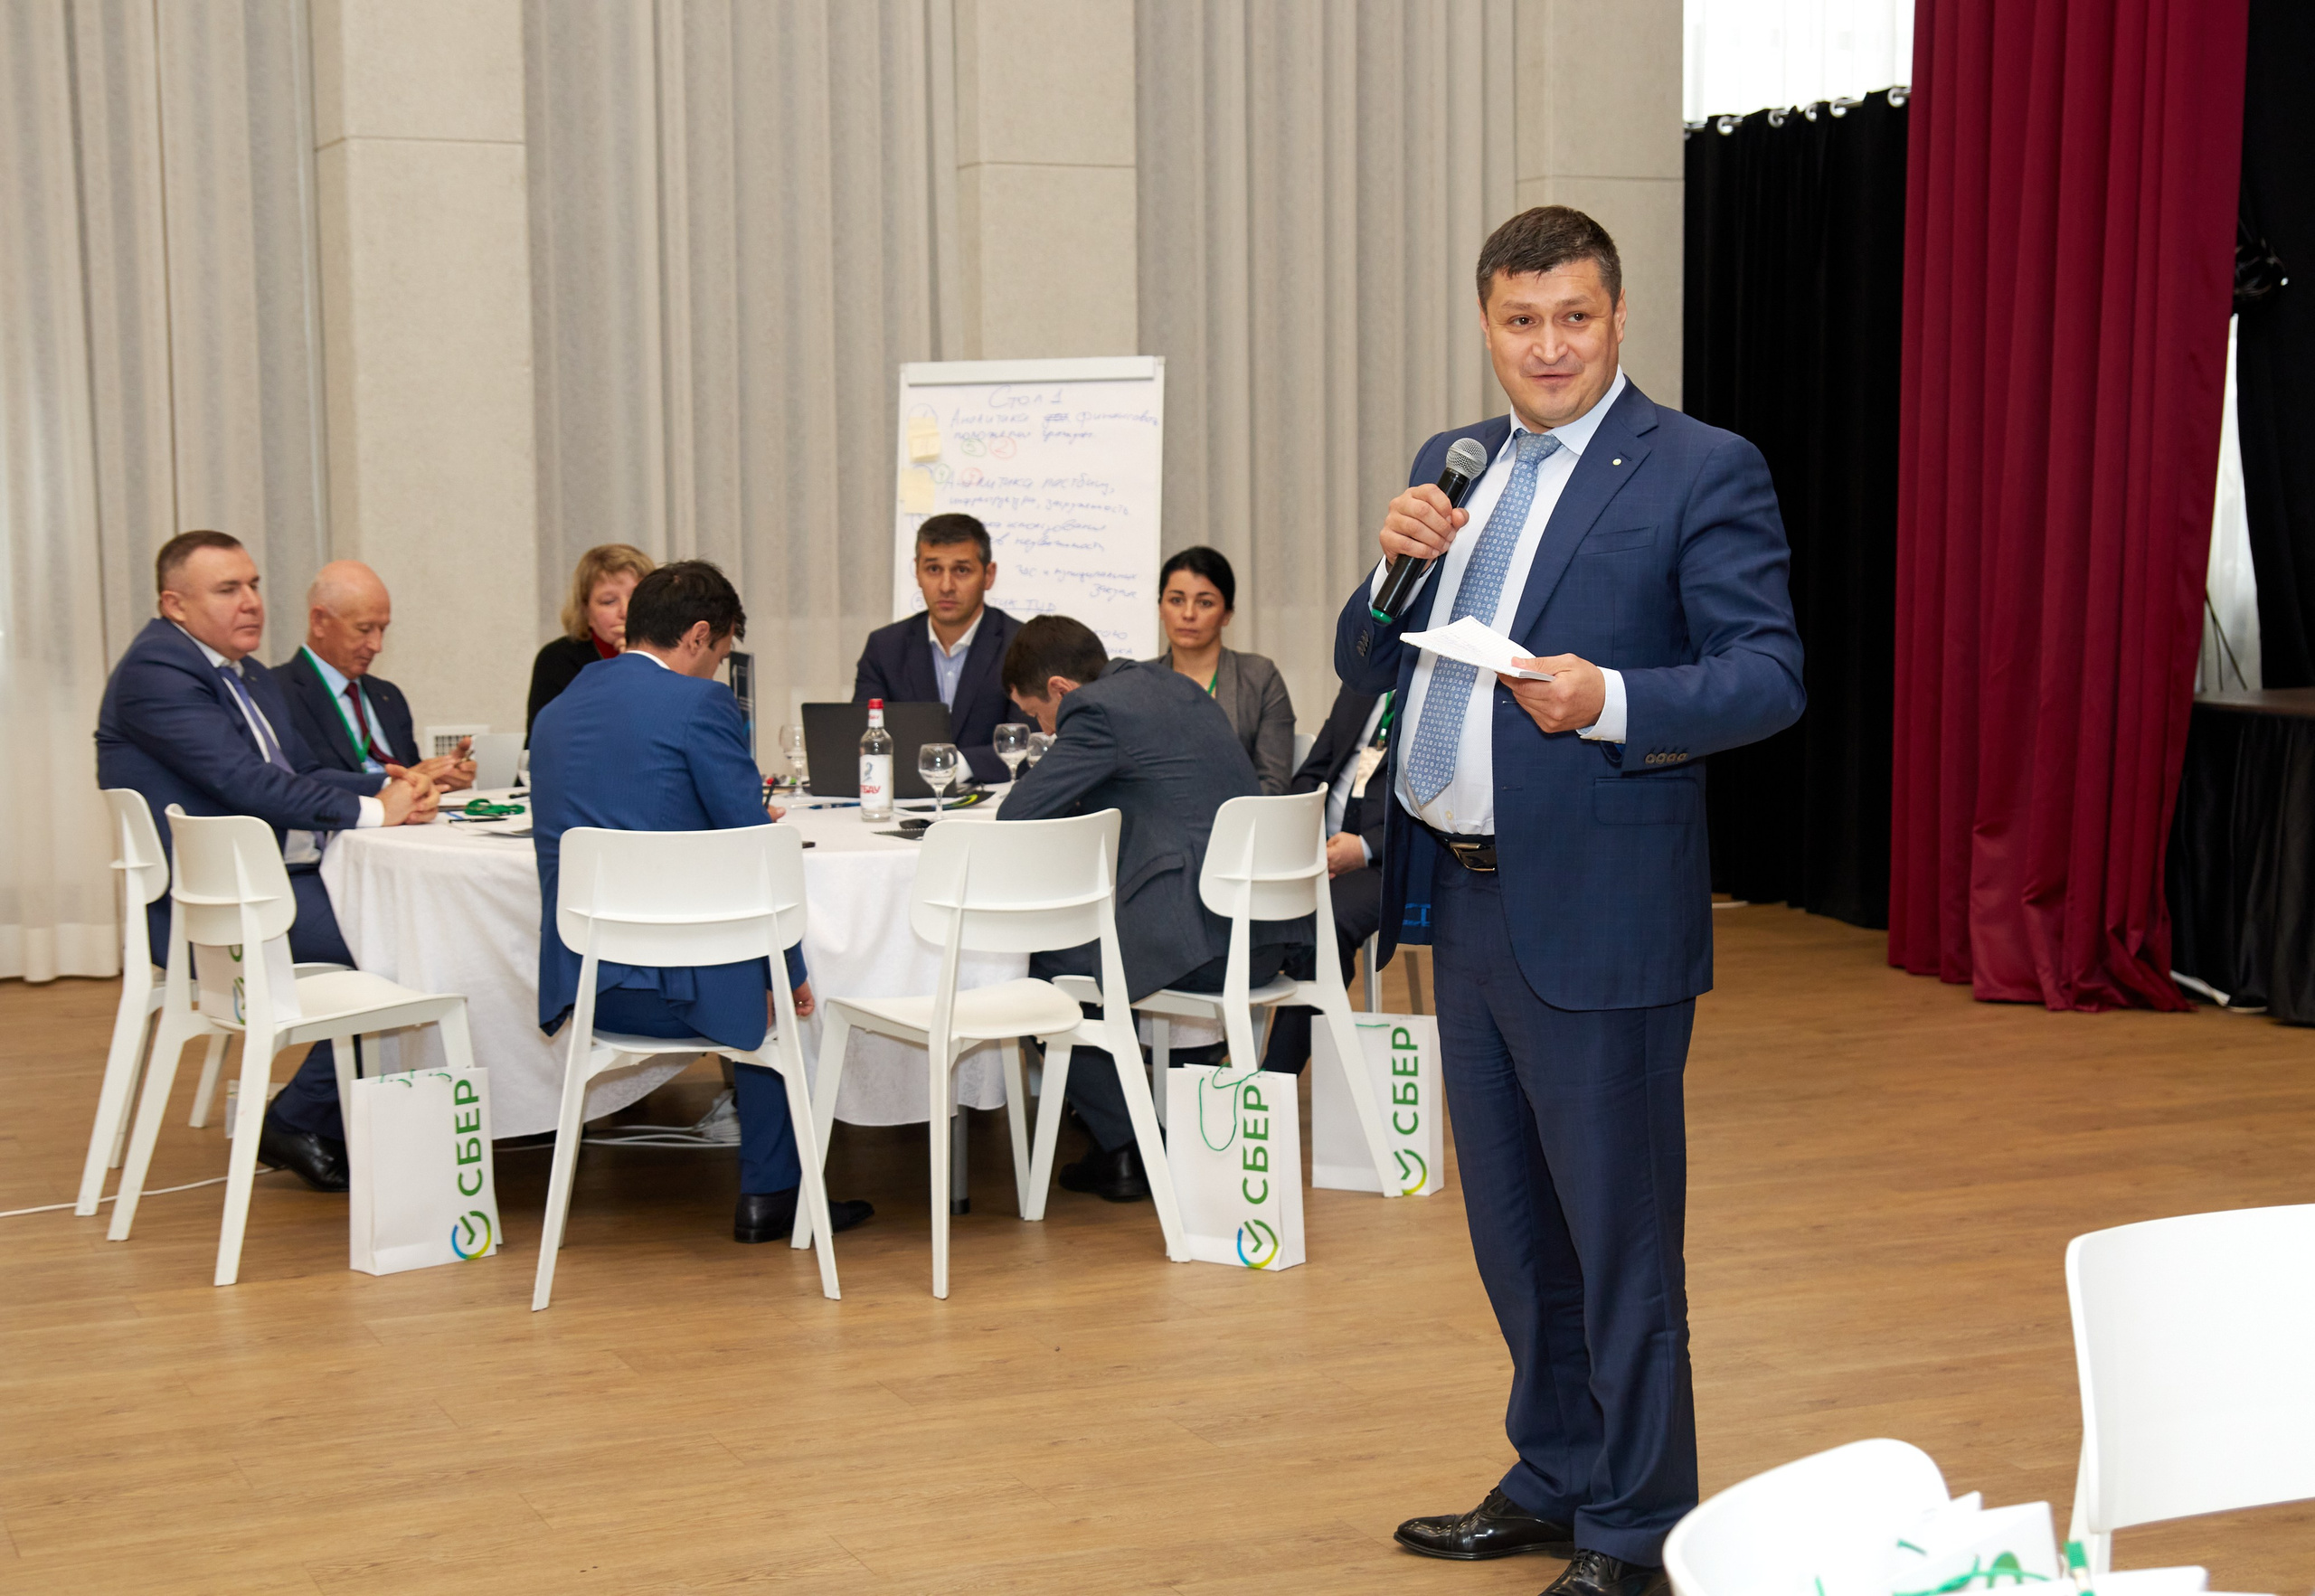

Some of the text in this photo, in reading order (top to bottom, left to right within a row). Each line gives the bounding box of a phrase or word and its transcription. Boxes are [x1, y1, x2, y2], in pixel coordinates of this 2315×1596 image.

[453, 1079, 483, 1197] СБЕР
[1391, 1026, 1419, 1136] СБЕР
[1242, 1084, 1270, 1204] СБЕР
